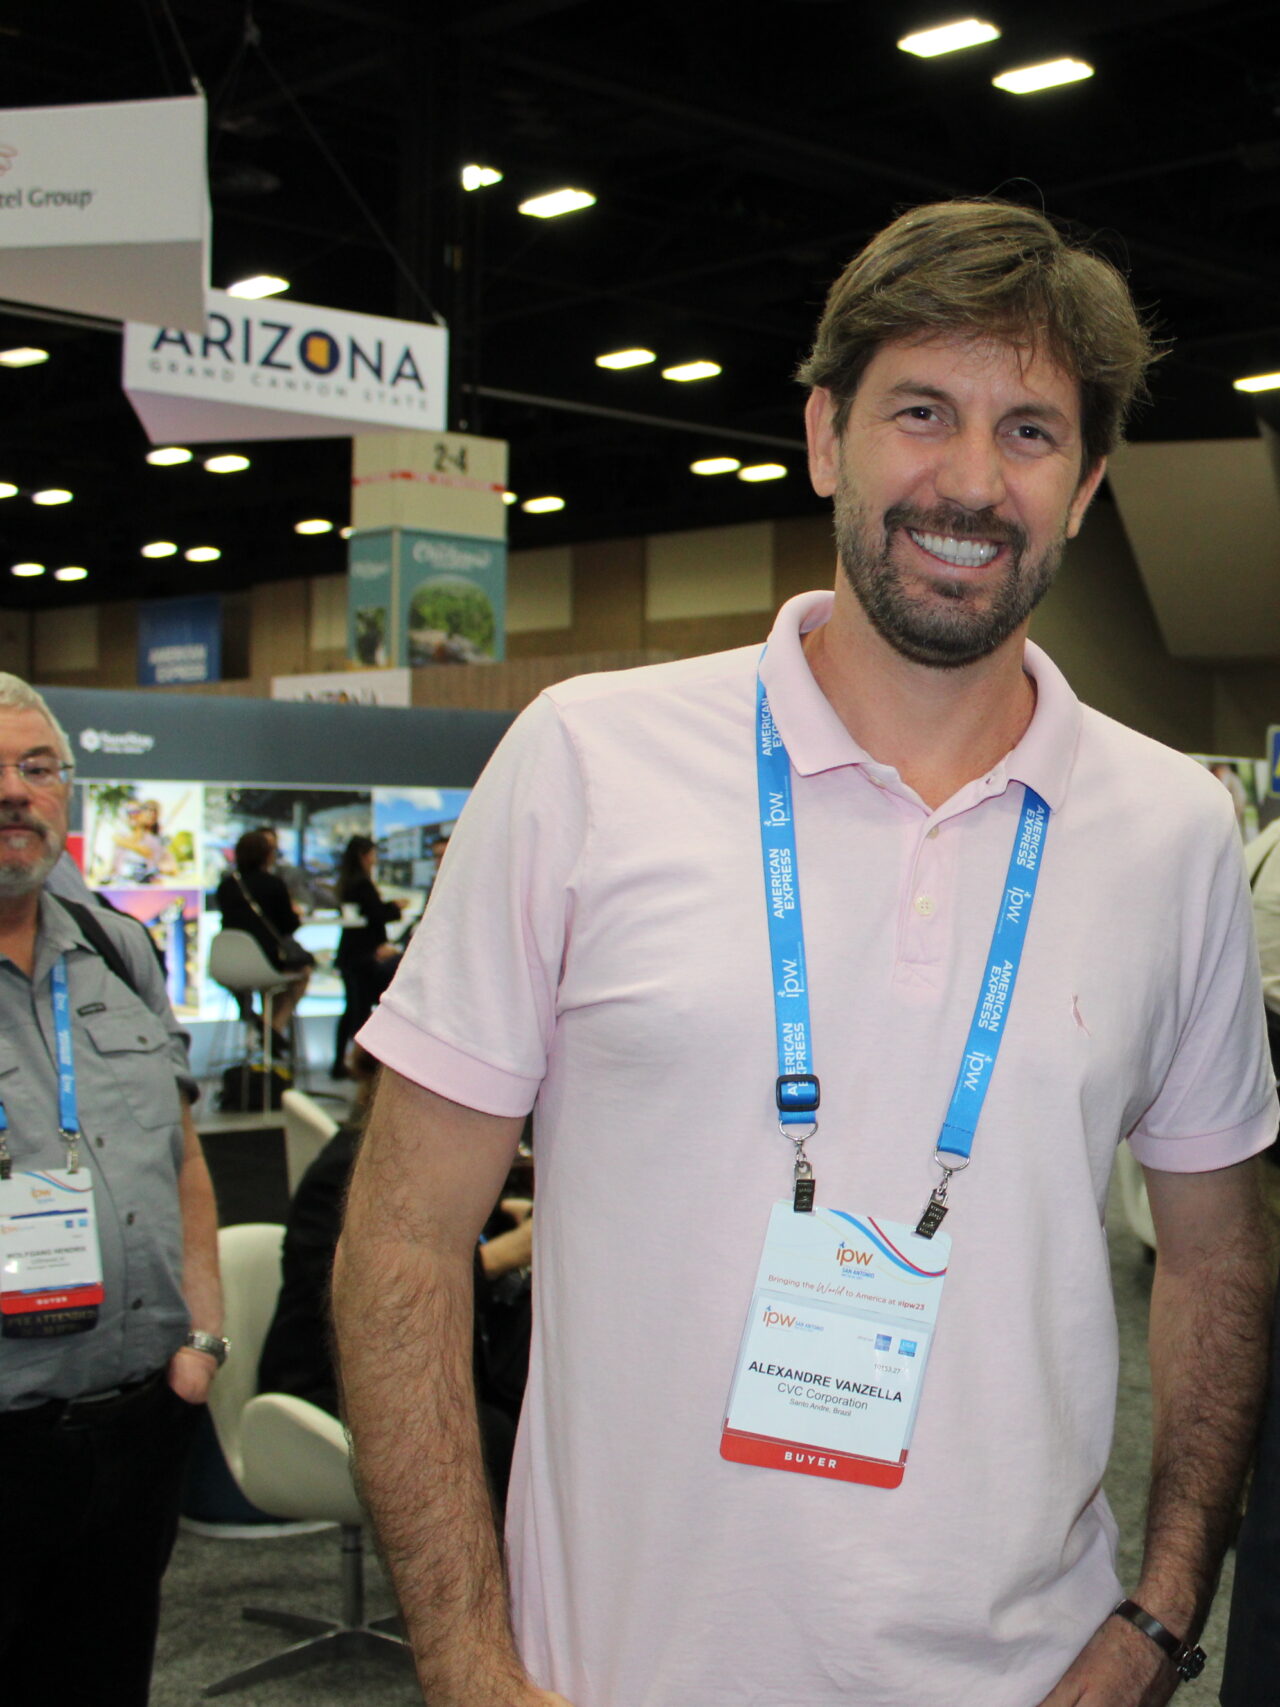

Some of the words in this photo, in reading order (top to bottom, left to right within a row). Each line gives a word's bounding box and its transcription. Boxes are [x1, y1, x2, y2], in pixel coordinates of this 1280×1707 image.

[28, 188, 93, 209] Group
[152, 312, 426, 390] ARIZONA
[252, 375, 347, 398] CANYON
[1017, 809, 1035, 866] EXPRESS
[1026, 805, 1045, 870] AMERICAN
[769, 848, 785, 919] AMERICAN
[780, 848, 794, 910] EXPRESS
[979, 966, 1002, 1029] EXPRESS
[988, 960, 1013, 1032] AMERICAN
[836, 1243, 874, 1266] ipw
[768, 1275, 800, 1288] Bringing
[802, 1281, 815, 1289] the
[816, 1281, 846, 1296] World
[856, 1293, 887, 1304] America
[762, 1305, 797, 1327] ipw
[748, 1361, 832, 1387] ALEXANDRE
[835, 1378, 902, 1402] VANZELLA
[777, 1383, 803, 1396] CVC
[806, 1388, 868, 1410] Corporation
[789, 1398, 809, 1408] Santo
[833, 1408, 851, 1417] Brazil
[784, 1451, 837, 1468] BUYER
